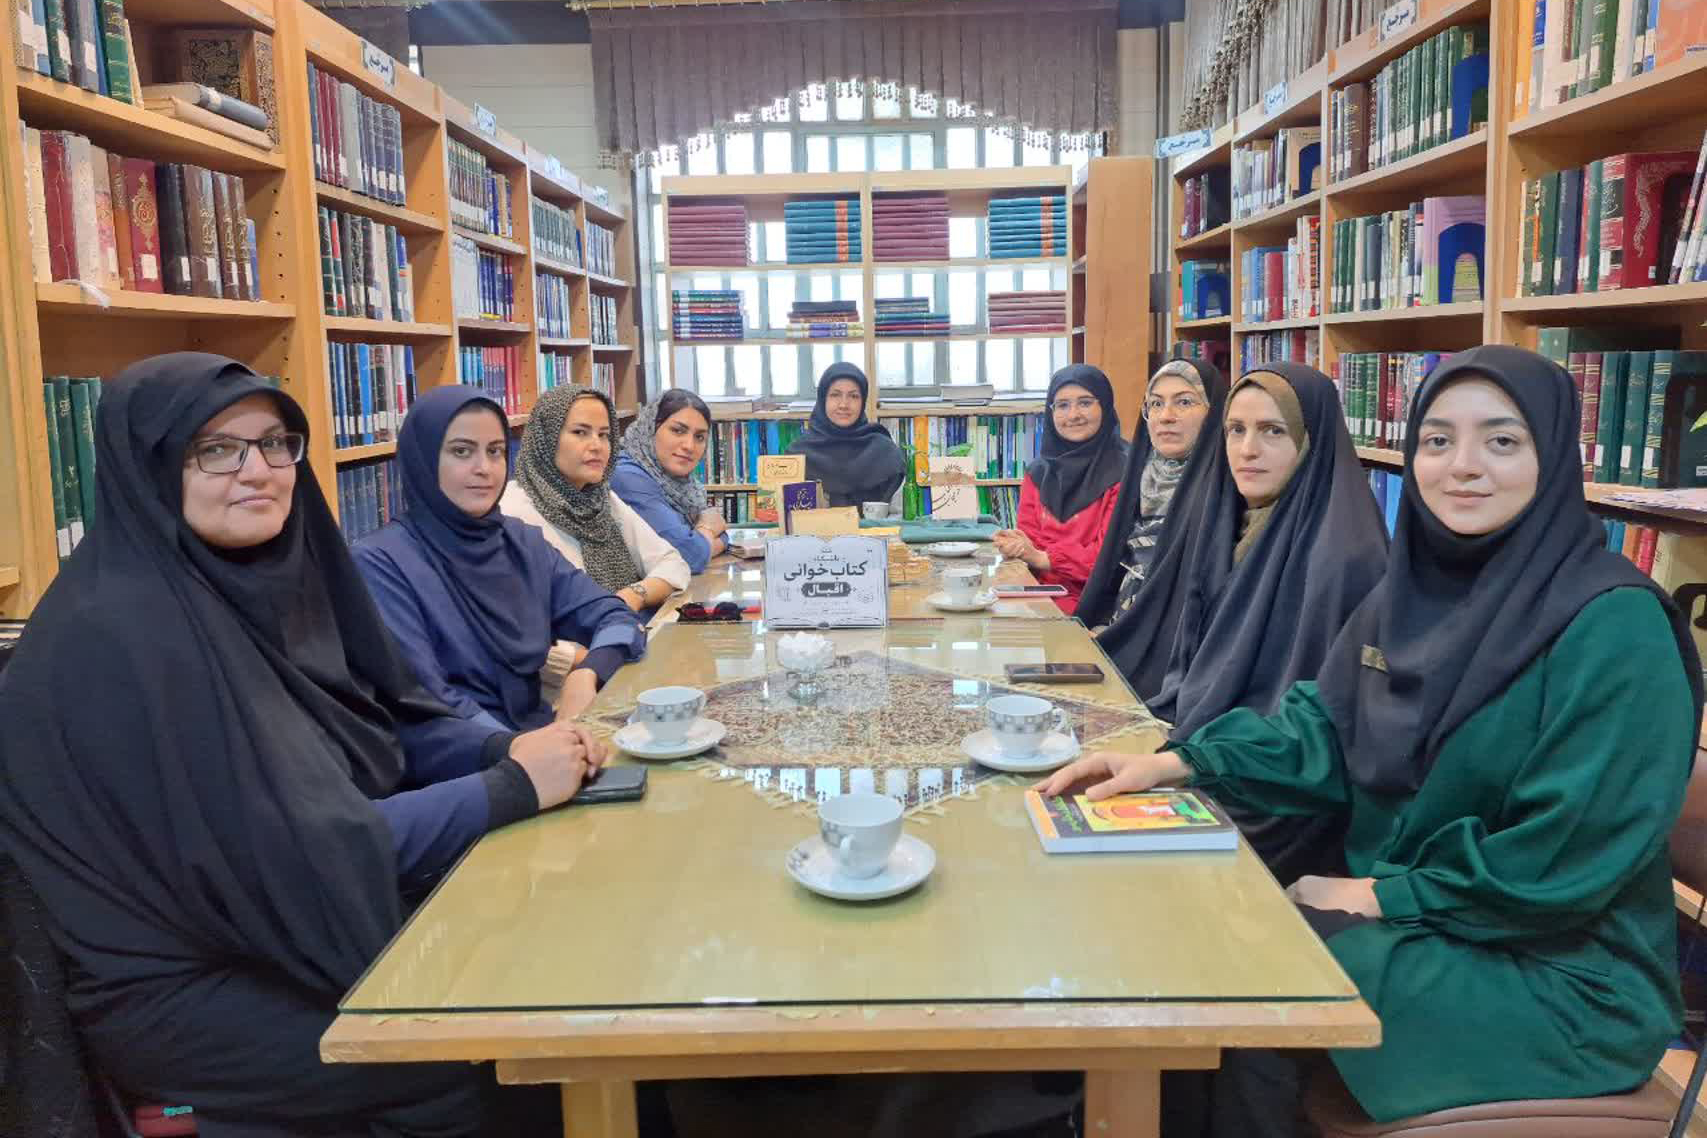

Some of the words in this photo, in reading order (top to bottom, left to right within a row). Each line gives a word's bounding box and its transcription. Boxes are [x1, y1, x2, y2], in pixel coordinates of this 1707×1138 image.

[783, 562, 829, 581] خوانی
[830, 560, 868, 580] کتاب
[807, 581, 844, 598] اقبال
